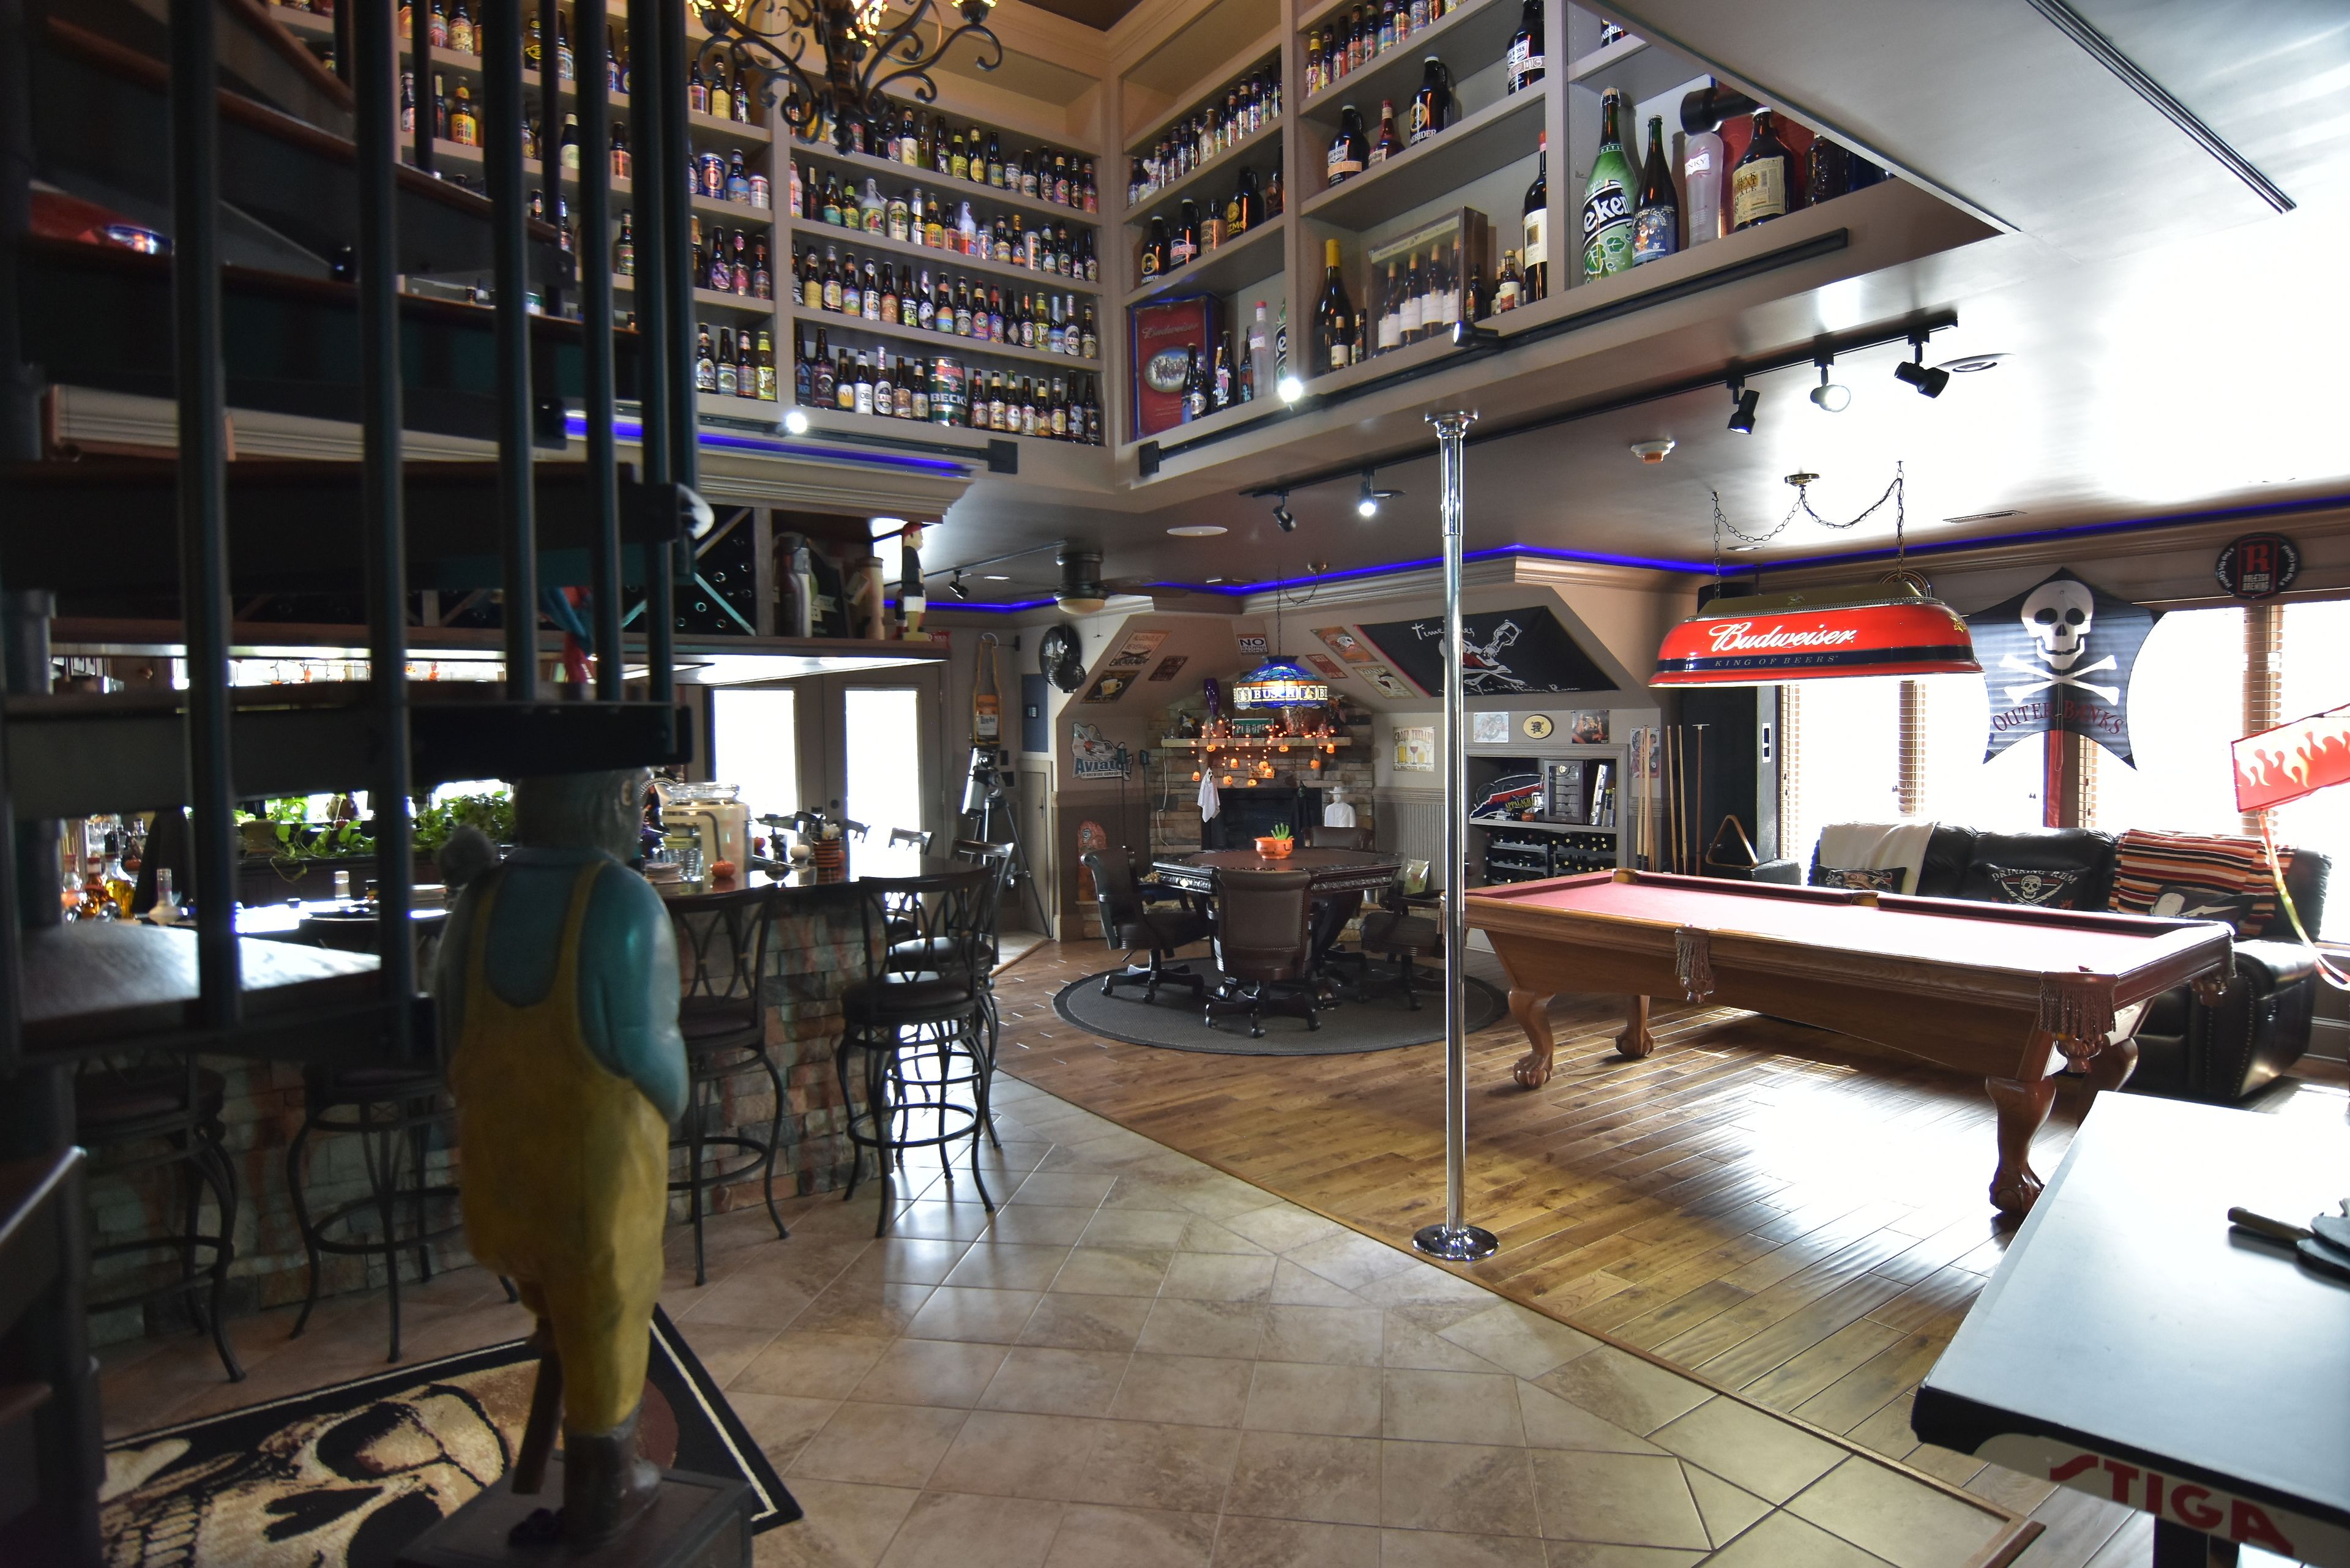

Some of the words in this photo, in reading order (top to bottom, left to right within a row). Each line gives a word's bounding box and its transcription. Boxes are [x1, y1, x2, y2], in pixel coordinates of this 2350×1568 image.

[1740, 185, 1757, 197] ALE
[2244, 544, 2270, 573] R
[1708, 621, 1857, 652] Budweiser
[1783, 655, 1835, 665] BEERS
[1993, 702, 2057, 731] OUTER
[2064, 700, 2125, 734] BANKS
[1991, 868, 2046, 882] DRINKING
[2050, 870, 2078, 884] RUM
